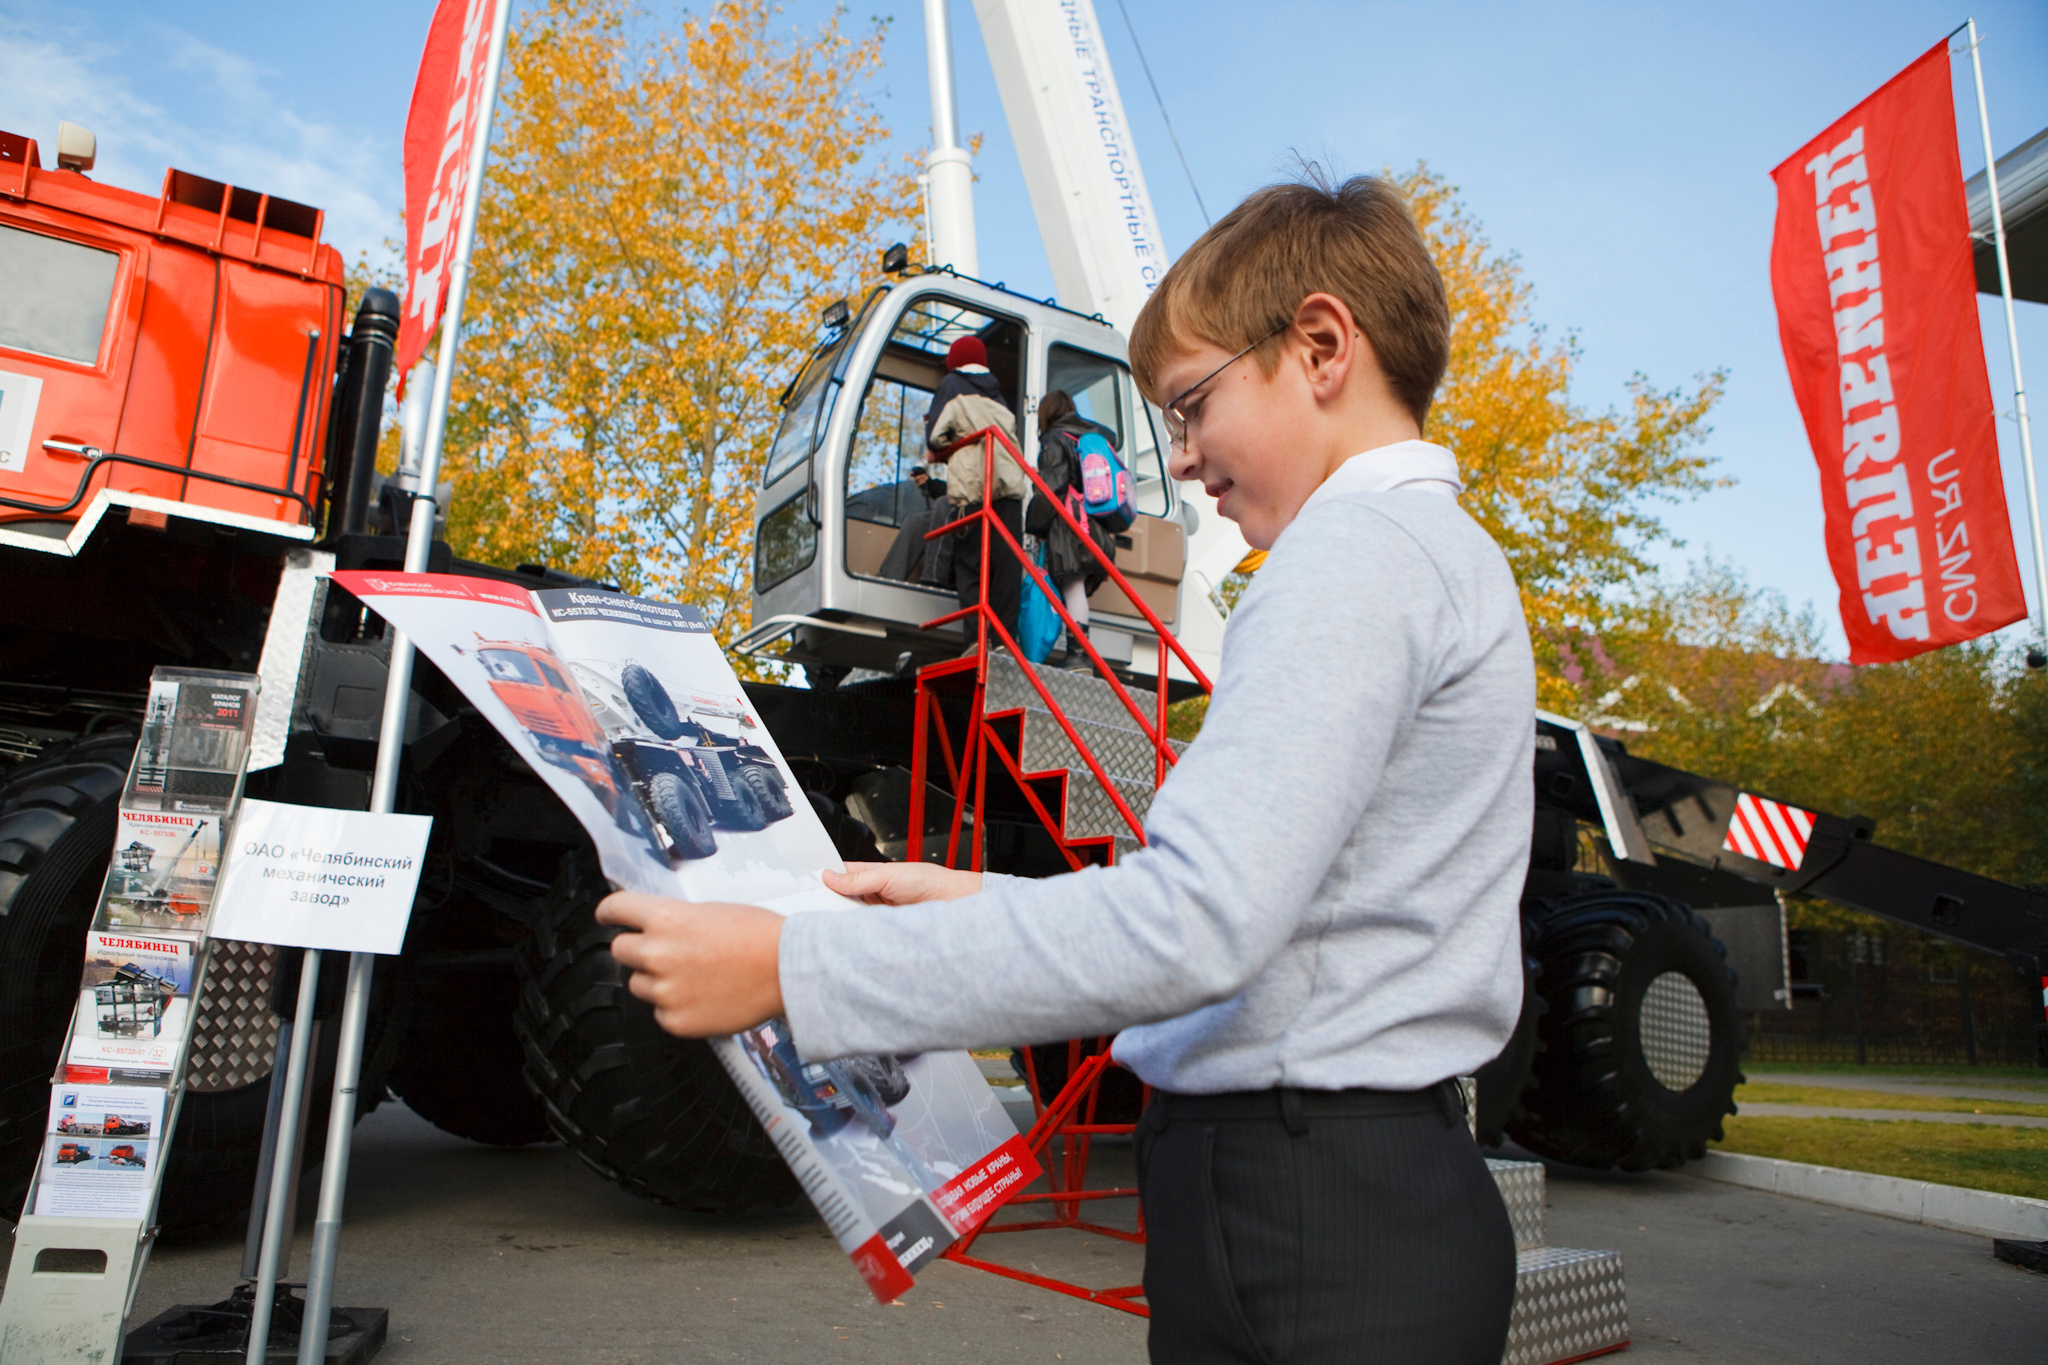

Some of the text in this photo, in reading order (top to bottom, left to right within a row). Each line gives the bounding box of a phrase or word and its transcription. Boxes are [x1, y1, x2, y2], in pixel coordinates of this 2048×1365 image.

[1082, 68, 1150, 258] ТРАНСПОРТНЫЕ
[567, 592, 683, 619] Кран-снегоболотоход
[211, 693, 241, 702] КАТАЛОГ
[216, 708, 238, 717] 2011
[122, 812, 194, 827] ЧЕЛЯБИНЕЦ
[244, 841, 413, 870] ОАО «Челябинский
[198, 866, 208, 874] 32
[262, 867, 385, 888] механический
[290, 890, 350, 907] завод»
[99, 936, 179, 955] ЧЕЛЯБИНЕЦ
[152, 1049, 164, 1058] 32
[962, 1168, 988, 1192] НОВЫЕ
[986, 1151, 1014, 1175] КРАНЫ,
[966, 1187, 997, 1214] БУДУЩЕЕ
[993, 1166, 1023, 1194] СТРАНЫ!
